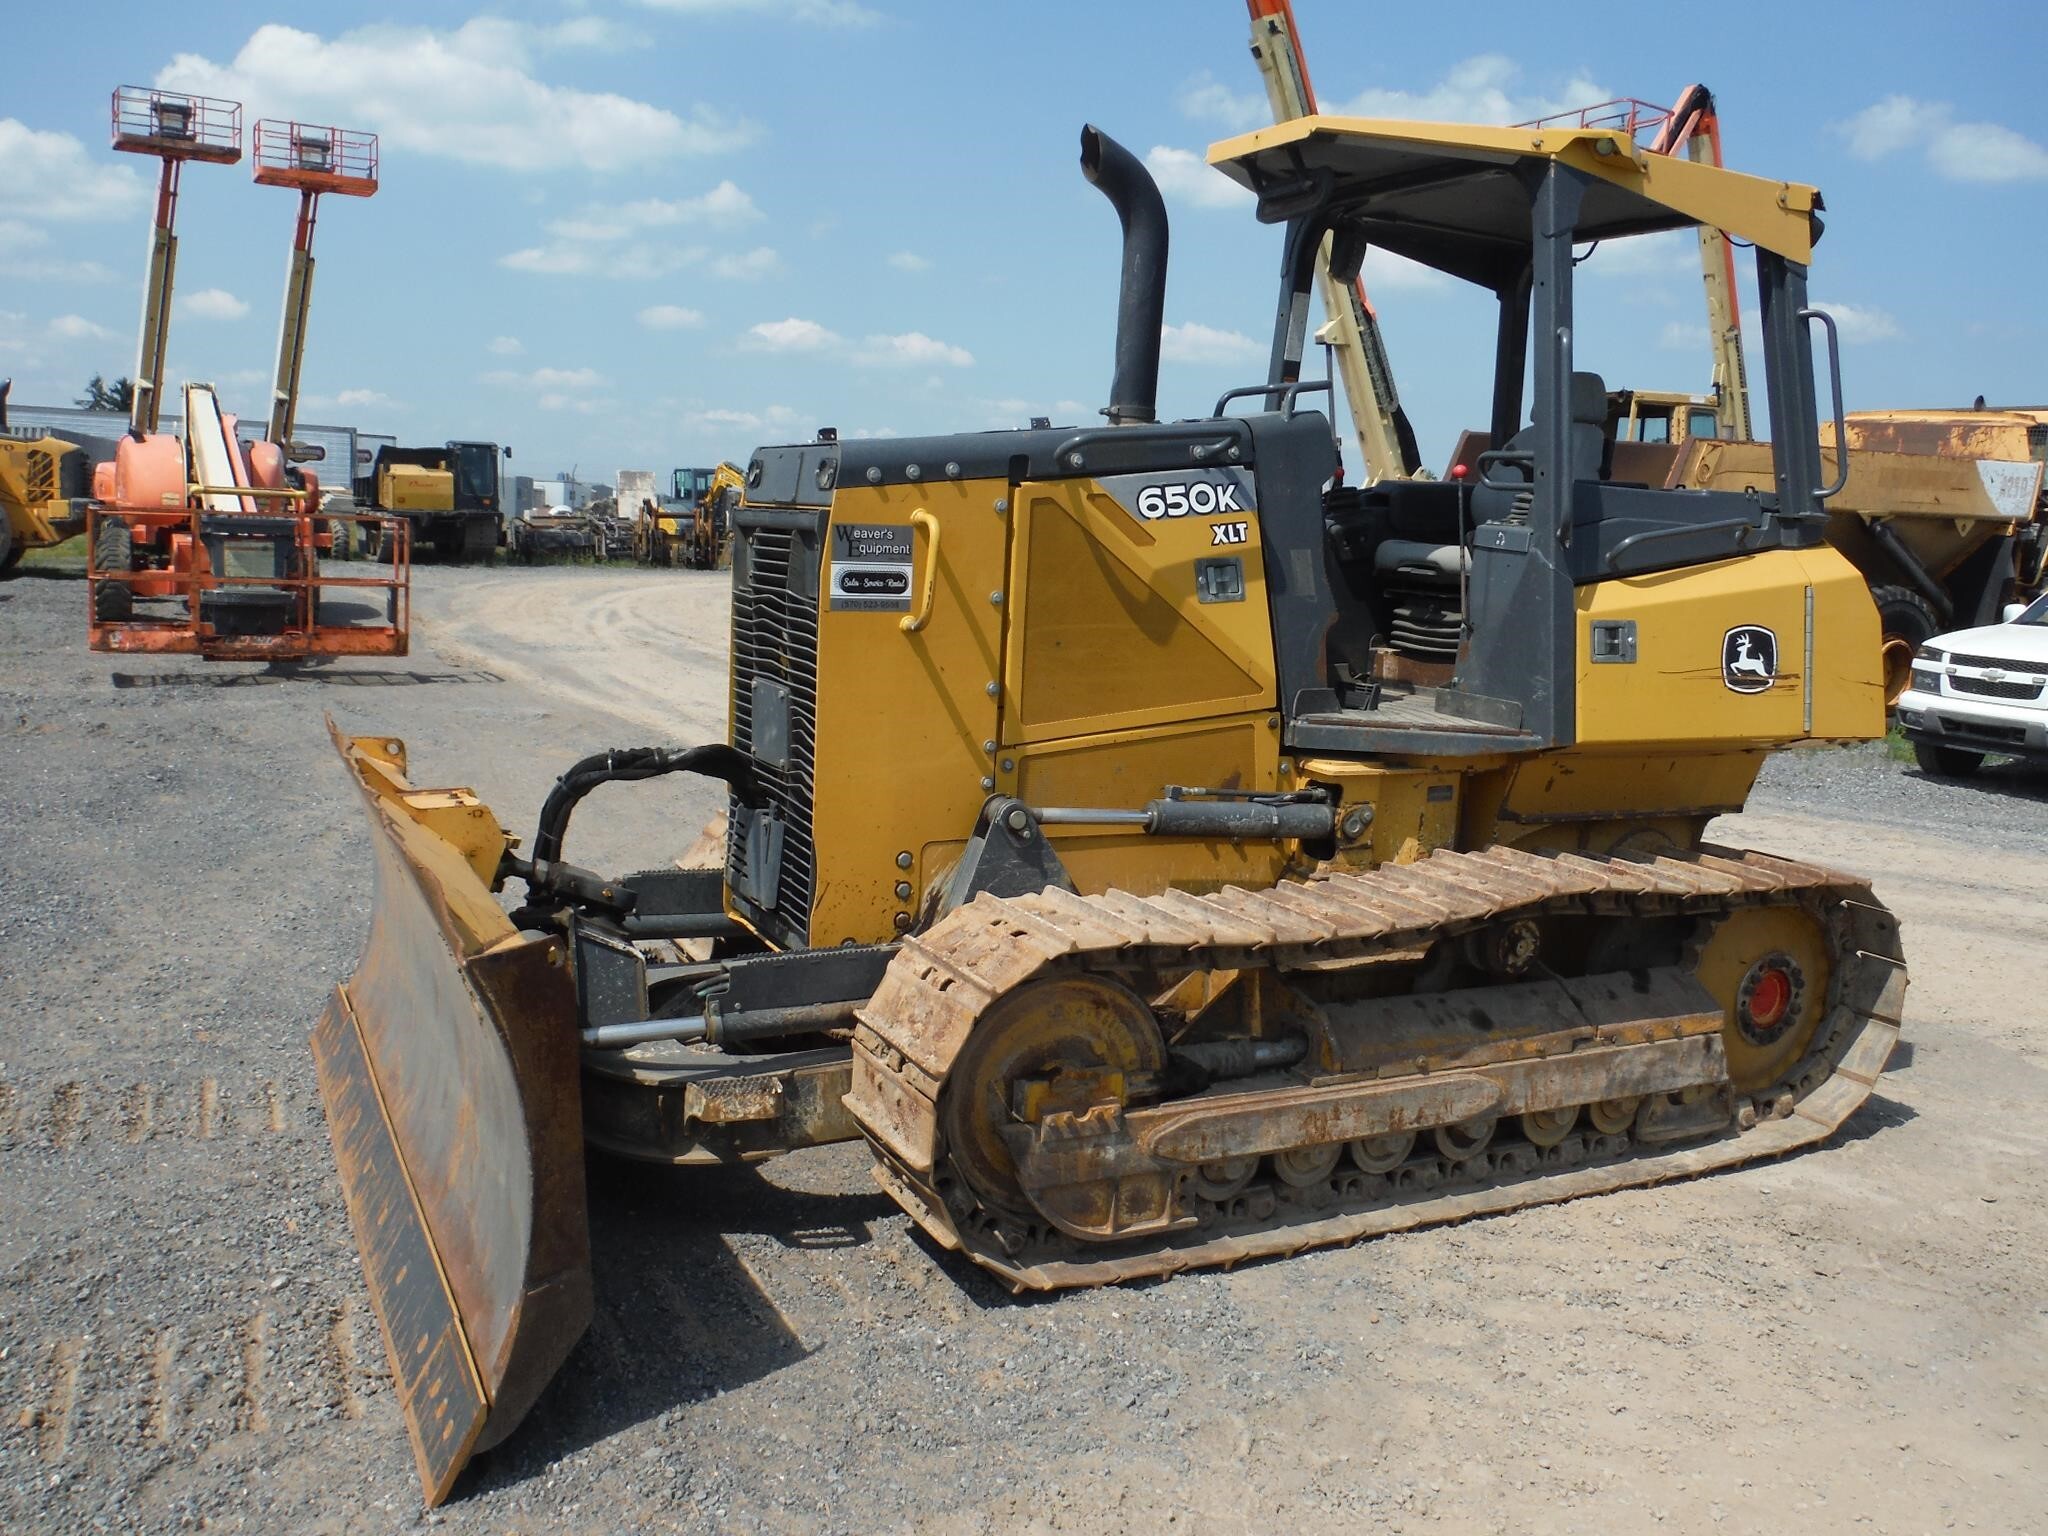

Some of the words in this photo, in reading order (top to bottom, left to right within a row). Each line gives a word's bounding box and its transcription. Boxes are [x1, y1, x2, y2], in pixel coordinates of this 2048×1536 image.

[1138, 482, 1244, 519] 650K
[836, 525, 893, 541] Weaver's
[1210, 521, 1248, 546] XLT
[848, 540, 911, 557] Equipment
